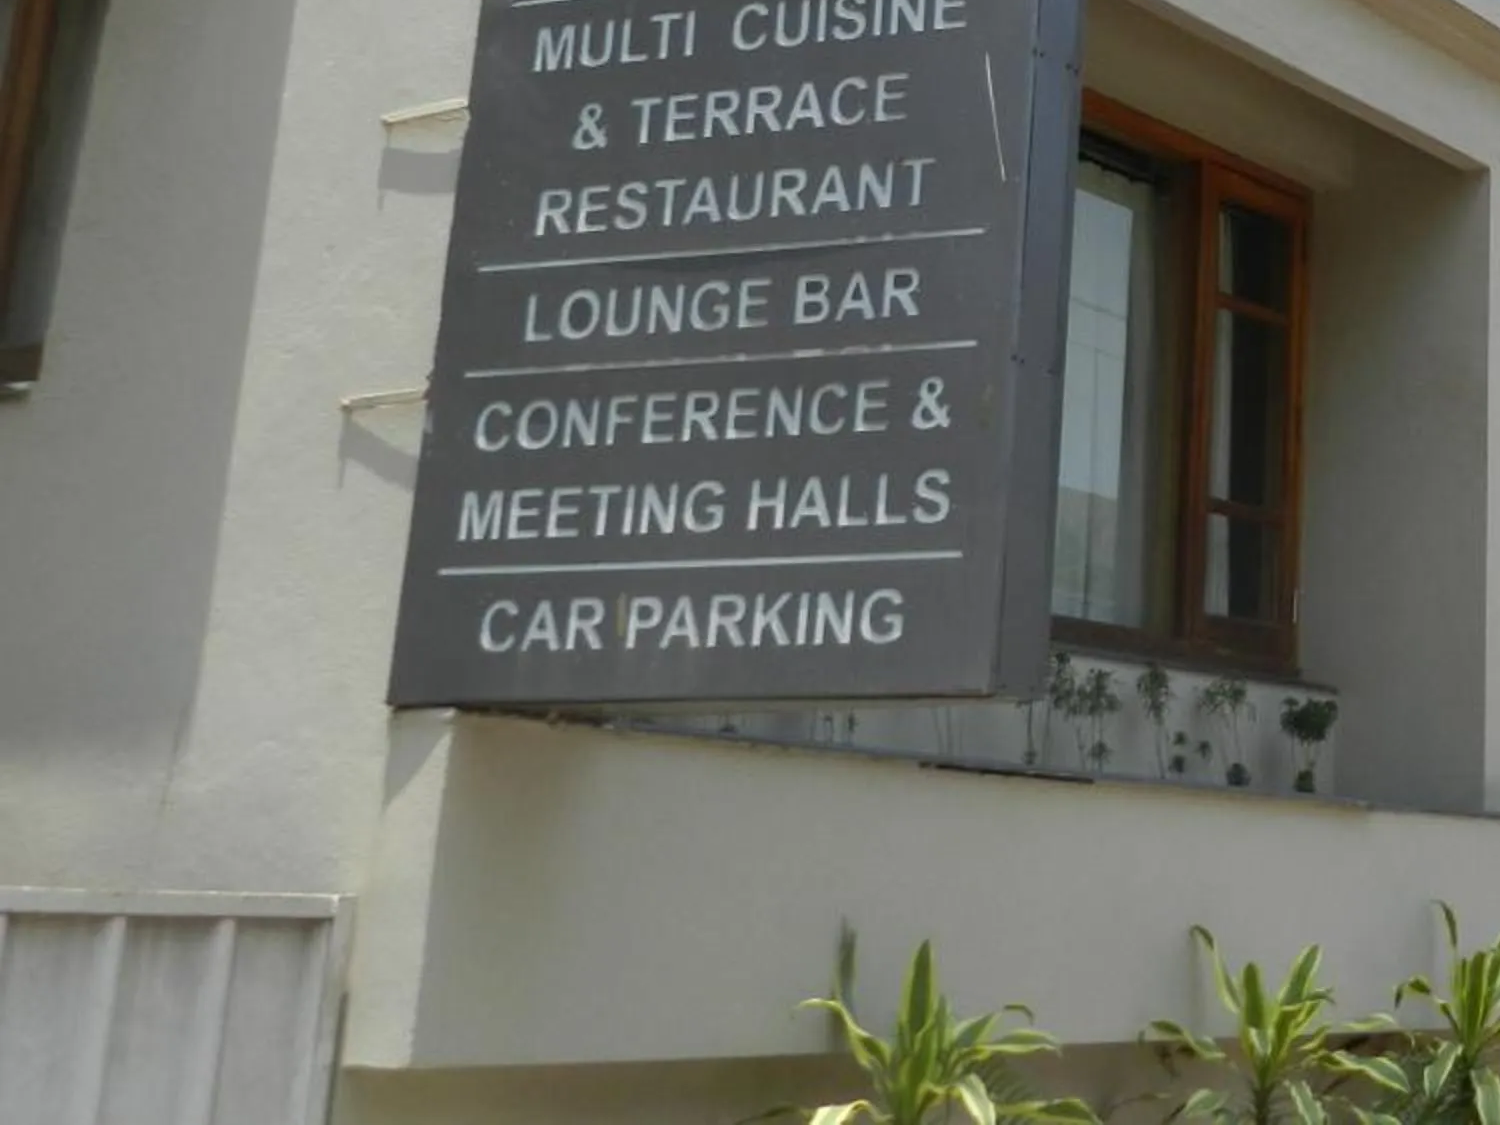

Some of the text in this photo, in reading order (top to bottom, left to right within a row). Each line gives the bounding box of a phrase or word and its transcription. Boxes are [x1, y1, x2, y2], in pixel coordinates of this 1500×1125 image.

[532, 10, 695, 73] MULTI
[572, 74, 908, 150] & TERRACE
[535, 159, 937, 236] RESTAURANT
[523, 268, 922, 343] LOUNGE BAR
[474, 376, 952, 452] CONFERENCE &
[456, 469, 952, 542] MEETING HALLS
[479, 588, 905, 653] CAR PARKING
